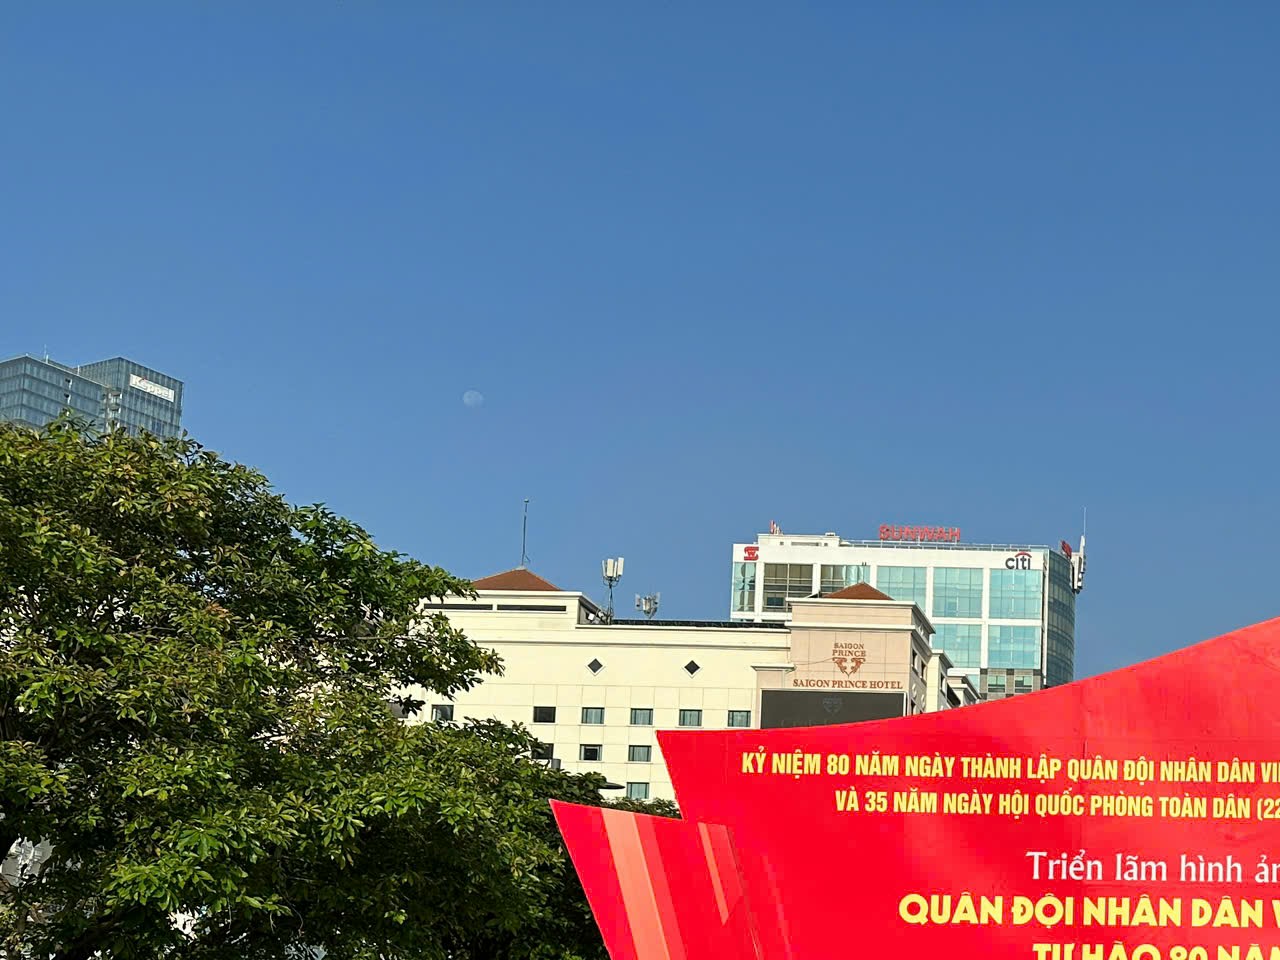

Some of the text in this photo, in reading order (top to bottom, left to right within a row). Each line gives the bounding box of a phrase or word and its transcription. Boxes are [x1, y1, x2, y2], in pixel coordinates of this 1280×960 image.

[879, 524, 961, 542] SUNWAH
[1005, 551, 1032, 570] citi
[832, 649, 867, 657] PRINCE
[833, 642, 865, 650] SAIGON
[793, 679, 903, 690] SAIGON PRINCE HOTEL
[742, 745, 767, 774] KỶ
[771, 749, 821, 779] NIỆM
[826, 753, 850, 775] 80
[855, 750, 900, 777] NĂM
[905, 752, 955, 778] NGÀY
[960, 753, 1022, 779] THÀNH
[1027, 752, 1062, 784] LẬP
[1067, 754, 1119, 782] QUÂN
[1123, 755, 1155, 785] ĐỘI
[1159, 756, 1212, 783] NHÂN
[1217, 757, 1255, 783] DÂN
[835, 786, 859, 812] VÀ
[864, 791, 888, 813] 35
[893, 787, 938, 814] NĂM
[943, 789, 993, 815] NGÀY
[998, 789, 1029, 820] HỘI
[1035, 787, 1085, 818] QUỐC
[1090, 790, 1154, 817] PHÒNG
[1158, 792, 1207, 818] TOÀN
[1213, 793, 1251, 819] DÂN
[1026, 849, 1103, 881] Triển
[1115, 853, 1167, 882] lãm
[1180, 854, 1243, 883] hình
[899, 891, 1003, 925] QUÂN
[1011, 892, 1074, 929] ĐỘI
[1084, 894, 1182, 927] NHÂN
[1191, 895, 1264, 929] DÂN
